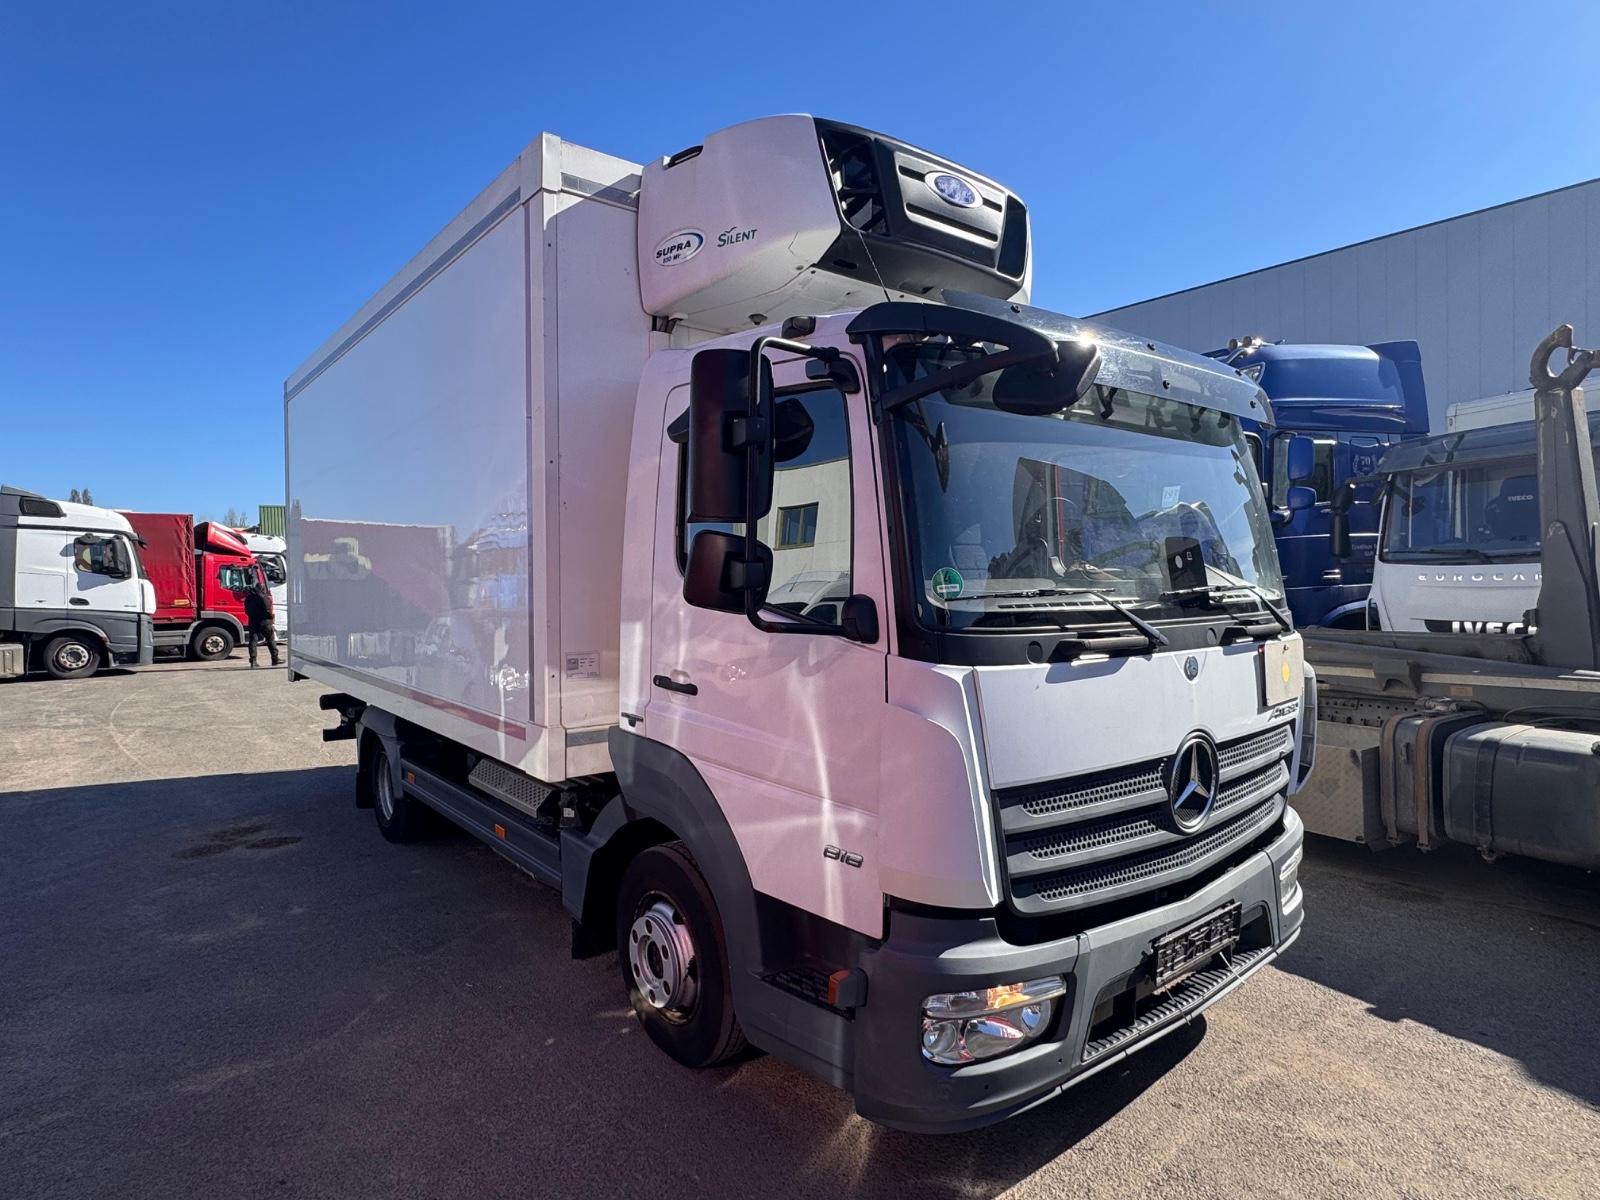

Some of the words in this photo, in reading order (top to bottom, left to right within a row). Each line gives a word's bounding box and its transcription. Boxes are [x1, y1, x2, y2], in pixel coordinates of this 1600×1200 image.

[717, 229, 757, 247] SILENT
[656, 240, 691, 258] SUPRA
[823, 845, 864, 868] 818
